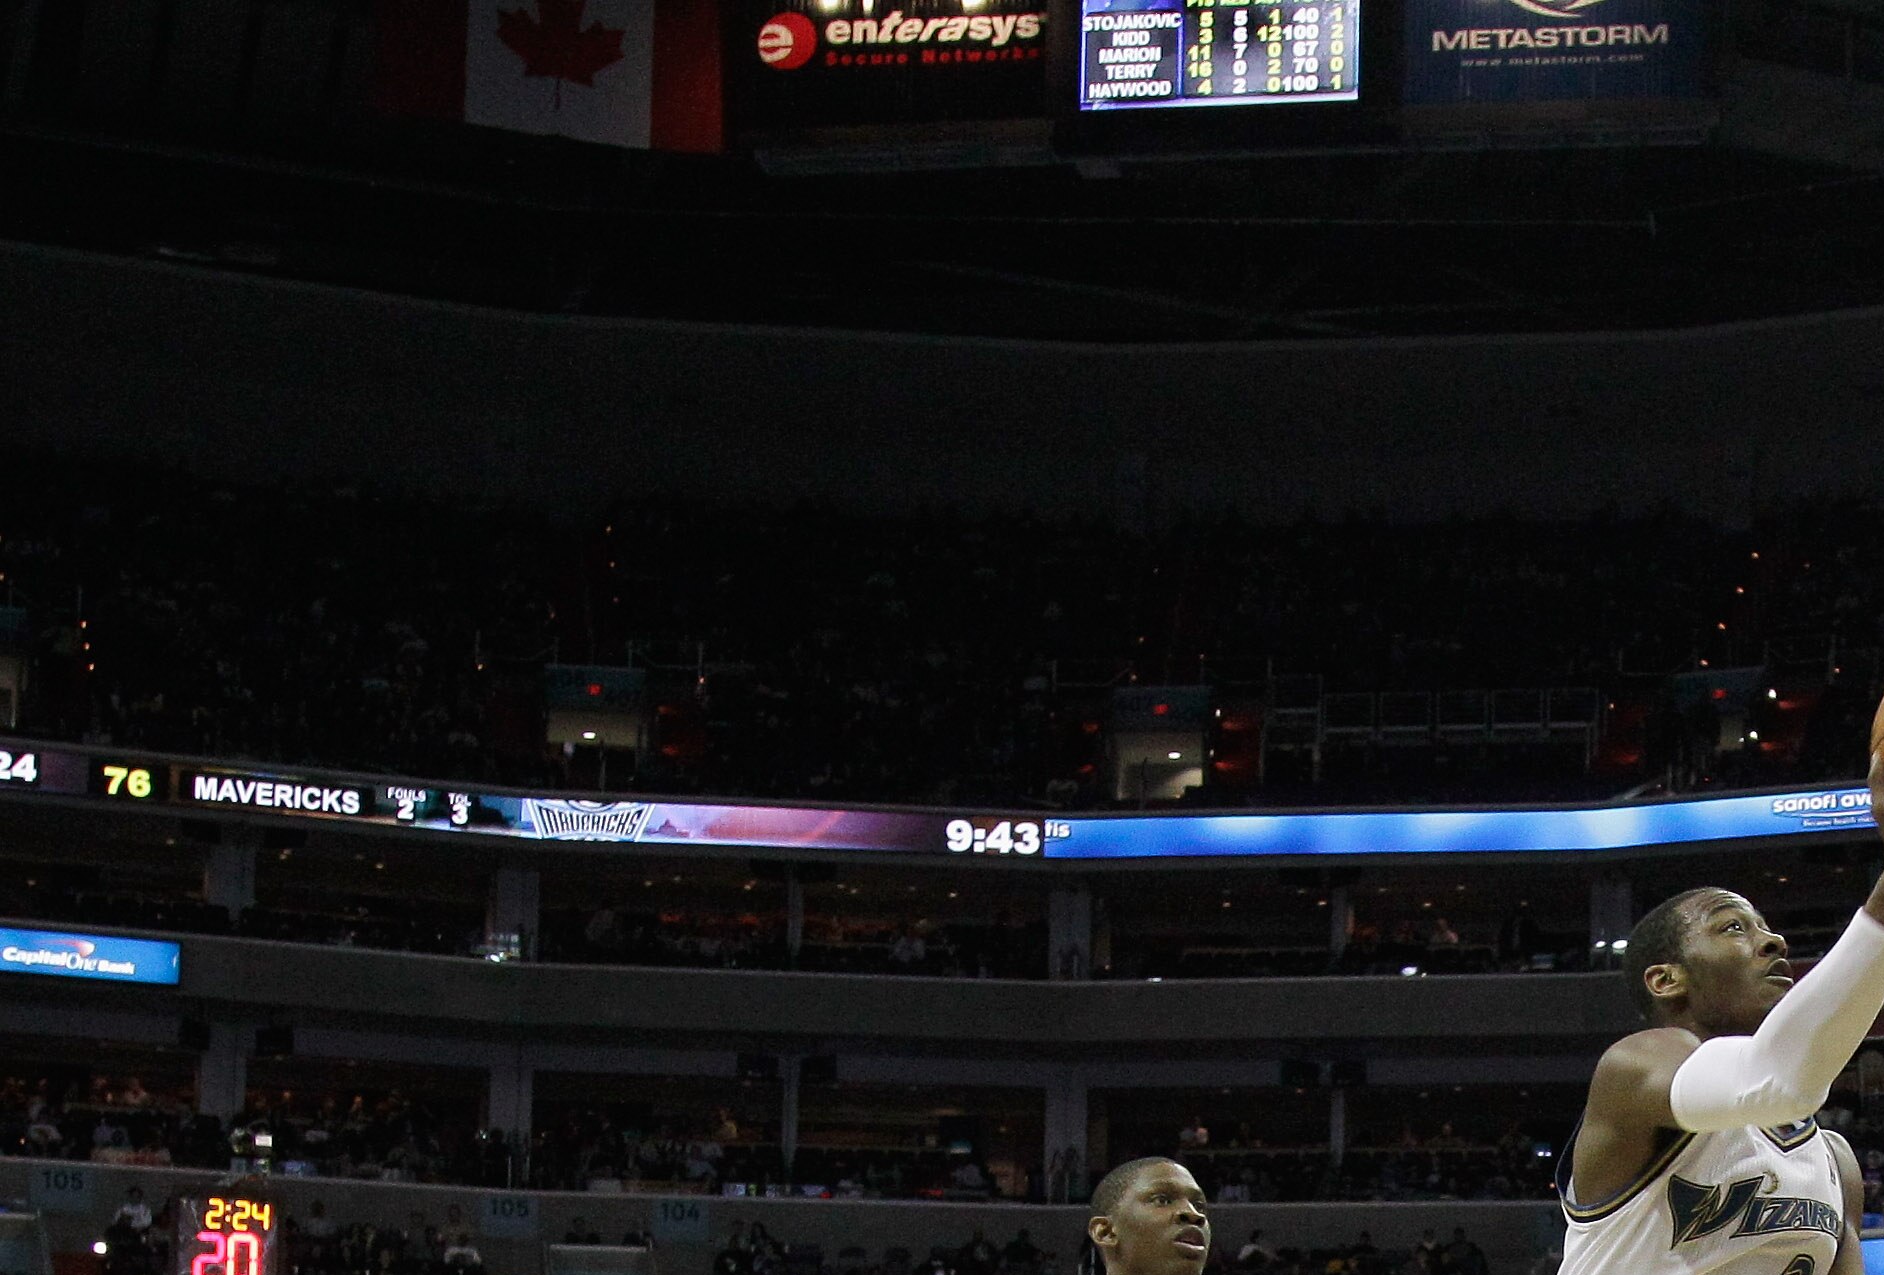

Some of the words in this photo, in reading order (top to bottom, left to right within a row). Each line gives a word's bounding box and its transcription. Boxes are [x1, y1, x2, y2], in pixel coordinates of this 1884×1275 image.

[825, 10, 1041, 47] enterasys
[1082, 13, 1182, 32] STOJAKOVIC
[1200, 11, 1213, 27] 5
[1233, 10, 1248, 26] 5
[1268, 9, 1281, 24] 1
[1292, 7, 1319, 23] 40
[1332, 6, 1343, 22] 1
[1112, 30, 1150, 47] KIDD
[1200, 28, 1213, 44] 3
[1233, 27, 1248, 42] 6
[1256, 25, 1282, 41] 12
[1282, 24, 1319, 40] 100
[1331, 23, 1344, 39] 2
[1432, 24, 1669, 51] METASTORM
[1098, 46, 1162, 64] MARION
[1187, 44, 1212, 61] 11
[1234, 43, 1248, 59] 7
[1267, 42, 1282, 58] 0
[1330, 40, 1344, 56] 0
[1105, 63, 1157, 80] TERRY
[1187, 61, 1213, 78] 16
[1232, 60, 1248, 76] 0
[1267, 59, 1281, 75] 2
[1292, 57, 1319, 74] 70
[1329, 56, 1344, 72] 0
[1089, 80, 1172, 99] HAYWOOD
[1197, 79, 1213, 95] 4
[1232, 78, 1247, 94] 2
[1266, 76, 1281, 93] 0
[1282, 75, 1319, 91] 100
[1331, 74, 1343, 90] 1
[103, 766, 151, 797] 76
[194, 776, 360, 814] MAVERICKS
[387, 787, 426, 802] FOULS
[1773, 794, 1837, 813] sanofi
[397, 801, 414, 819] 2
[452, 804, 468, 825] 3
[538, 806, 645, 835] MAVERICKS
[946, 819, 1040, 854] 9:43
[44, 1171, 84, 1190] 105
[205, 1198, 270, 1231] 2:24
[660, 1202, 700, 1222] 104
